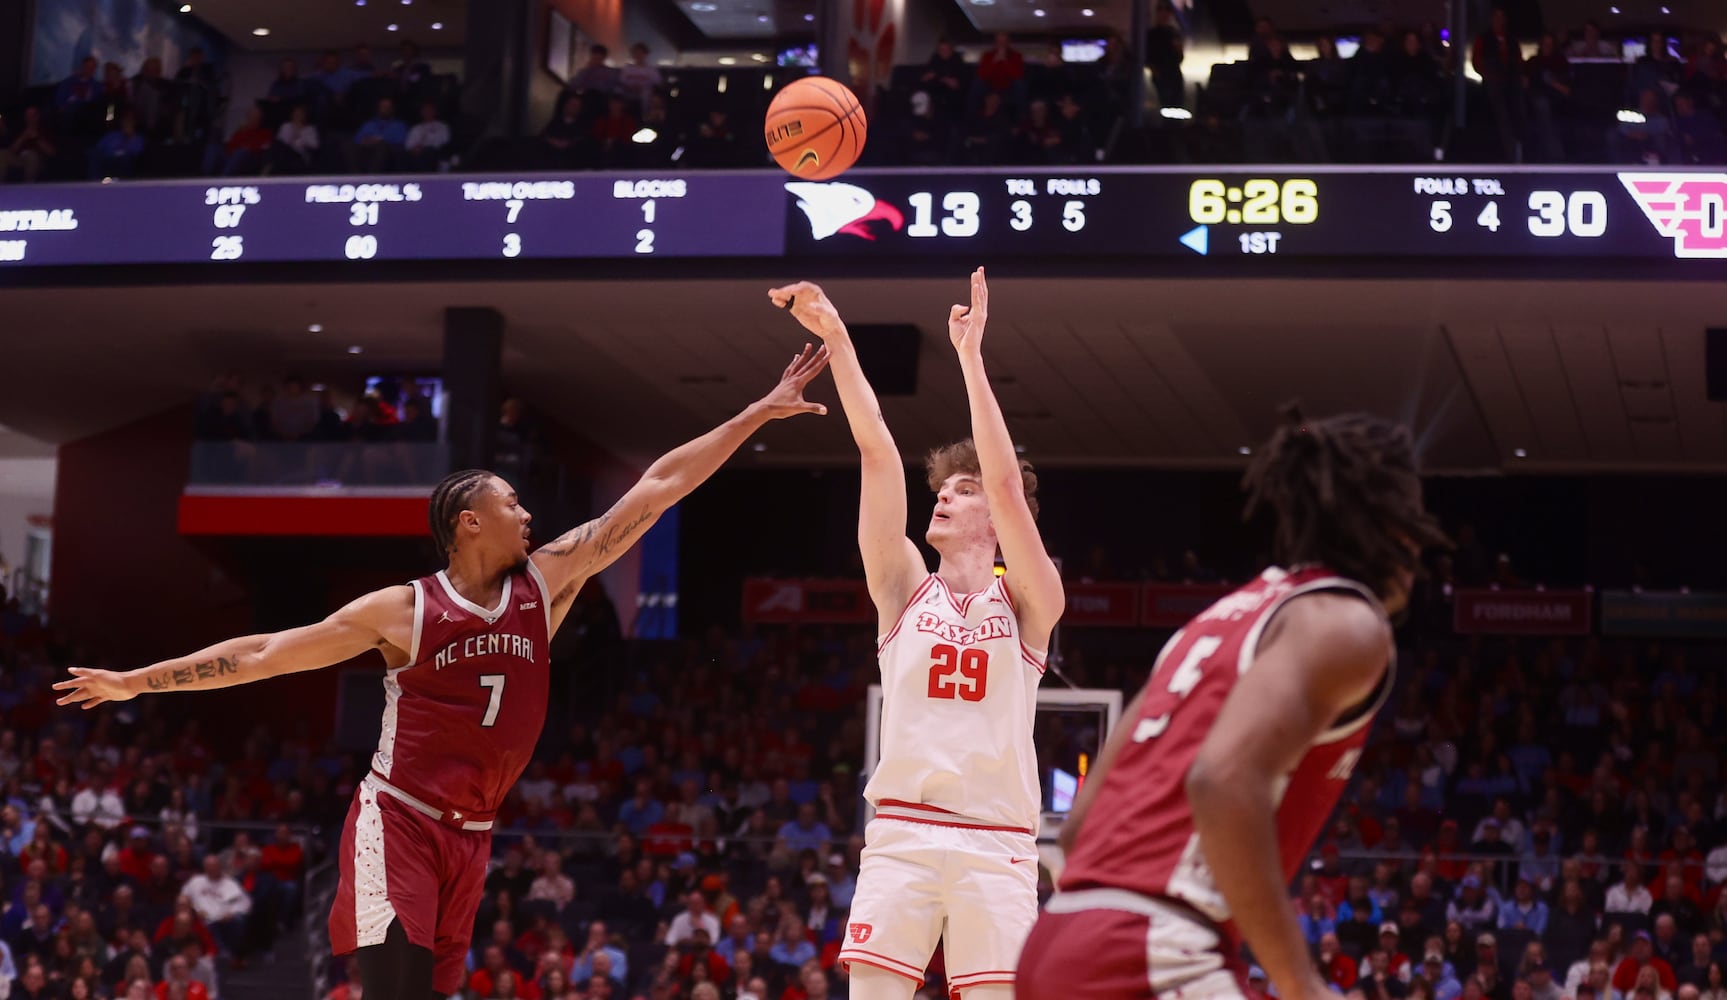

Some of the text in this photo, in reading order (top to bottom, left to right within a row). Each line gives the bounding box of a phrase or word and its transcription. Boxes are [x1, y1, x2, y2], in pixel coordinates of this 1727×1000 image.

[305, 183, 422, 203] FIELD GOAL %
[614, 180, 687, 198] BLOCKS
[1005, 178, 1101, 195] TOL FOULS
[1414, 177, 1506, 195] FOULS TOL
[349, 202, 379, 226] 31
[505, 199, 524, 224] 7
[641, 199, 656, 224] 1
[1189, 179, 1319, 224] 6:26
[1527, 190, 1608, 237] 30
[214, 204, 246, 229] 67
[907, 192, 980, 237] 13
[1009, 200, 1086, 232] 3 5
[1429, 200, 1501, 232] 5 4
[210, 235, 244, 260] 25
[502, 232, 522, 257] 3
[634, 228, 655, 254] 2
[1238, 231, 1282, 254] 1ST
[1471, 602, 1572, 621] FORDHAM
[916, 611, 1012, 646] DAYTON
[435, 633, 535, 671] NC CENTRAL
[927, 643, 989, 702] 29
[479, 673, 506, 727] 7
